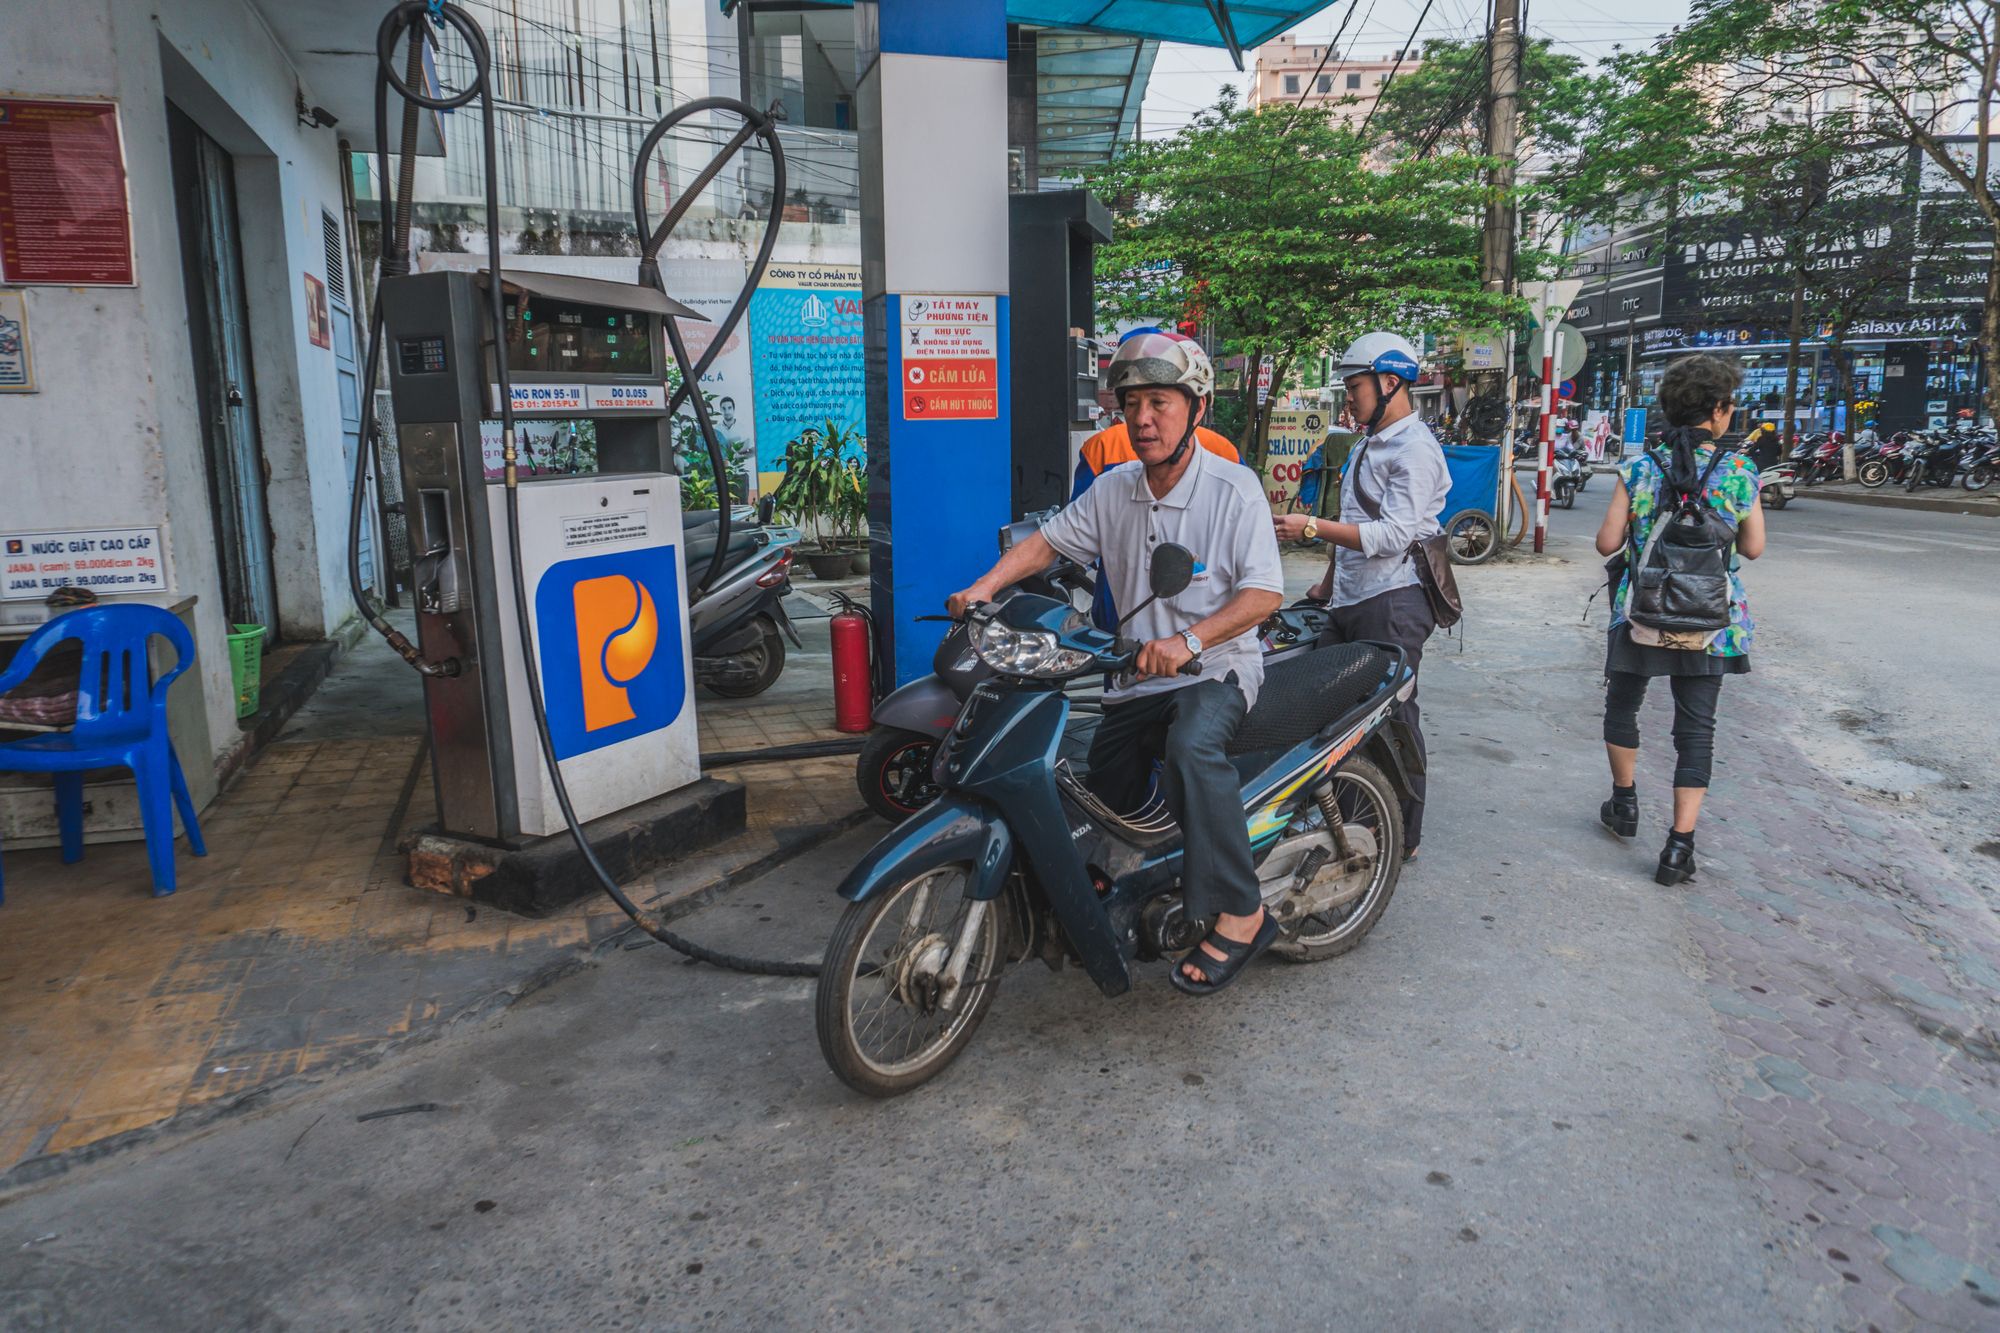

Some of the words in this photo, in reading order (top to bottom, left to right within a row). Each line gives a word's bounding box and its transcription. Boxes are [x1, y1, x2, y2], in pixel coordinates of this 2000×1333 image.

[770, 268, 795, 278] CÔNG
[1568, 306, 1590, 320] NOKIA
[930, 364, 958, 383] CẤM
[962, 364, 986, 383] LỬA
[510, 387, 529, 400] ĂNG
[532, 388, 551, 399] RON
[612, 388, 624, 398] DO
[626, 388, 648, 398] 0.05S
[1308, 418, 1319, 427] 76
[1266, 435, 1296, 456] CHÂU
[32, 540, 64, 554] NƯỚC
[68, 538, 96, 555] GIẶT
[100, 539, 124, 550] CAO
[128, 534, 151, 550] CẤP
[6, 563, 36, 574] JANA
[40, 562, 70, 574] (cam):
[136, 556, 156, 568] 2kg
[10, 579, 38, 590] JANA
[42, 577, 73, 588] BLUE:
[138, 573, 156, 584] 2kg
[1072, 823, 1092, 840] NDA
